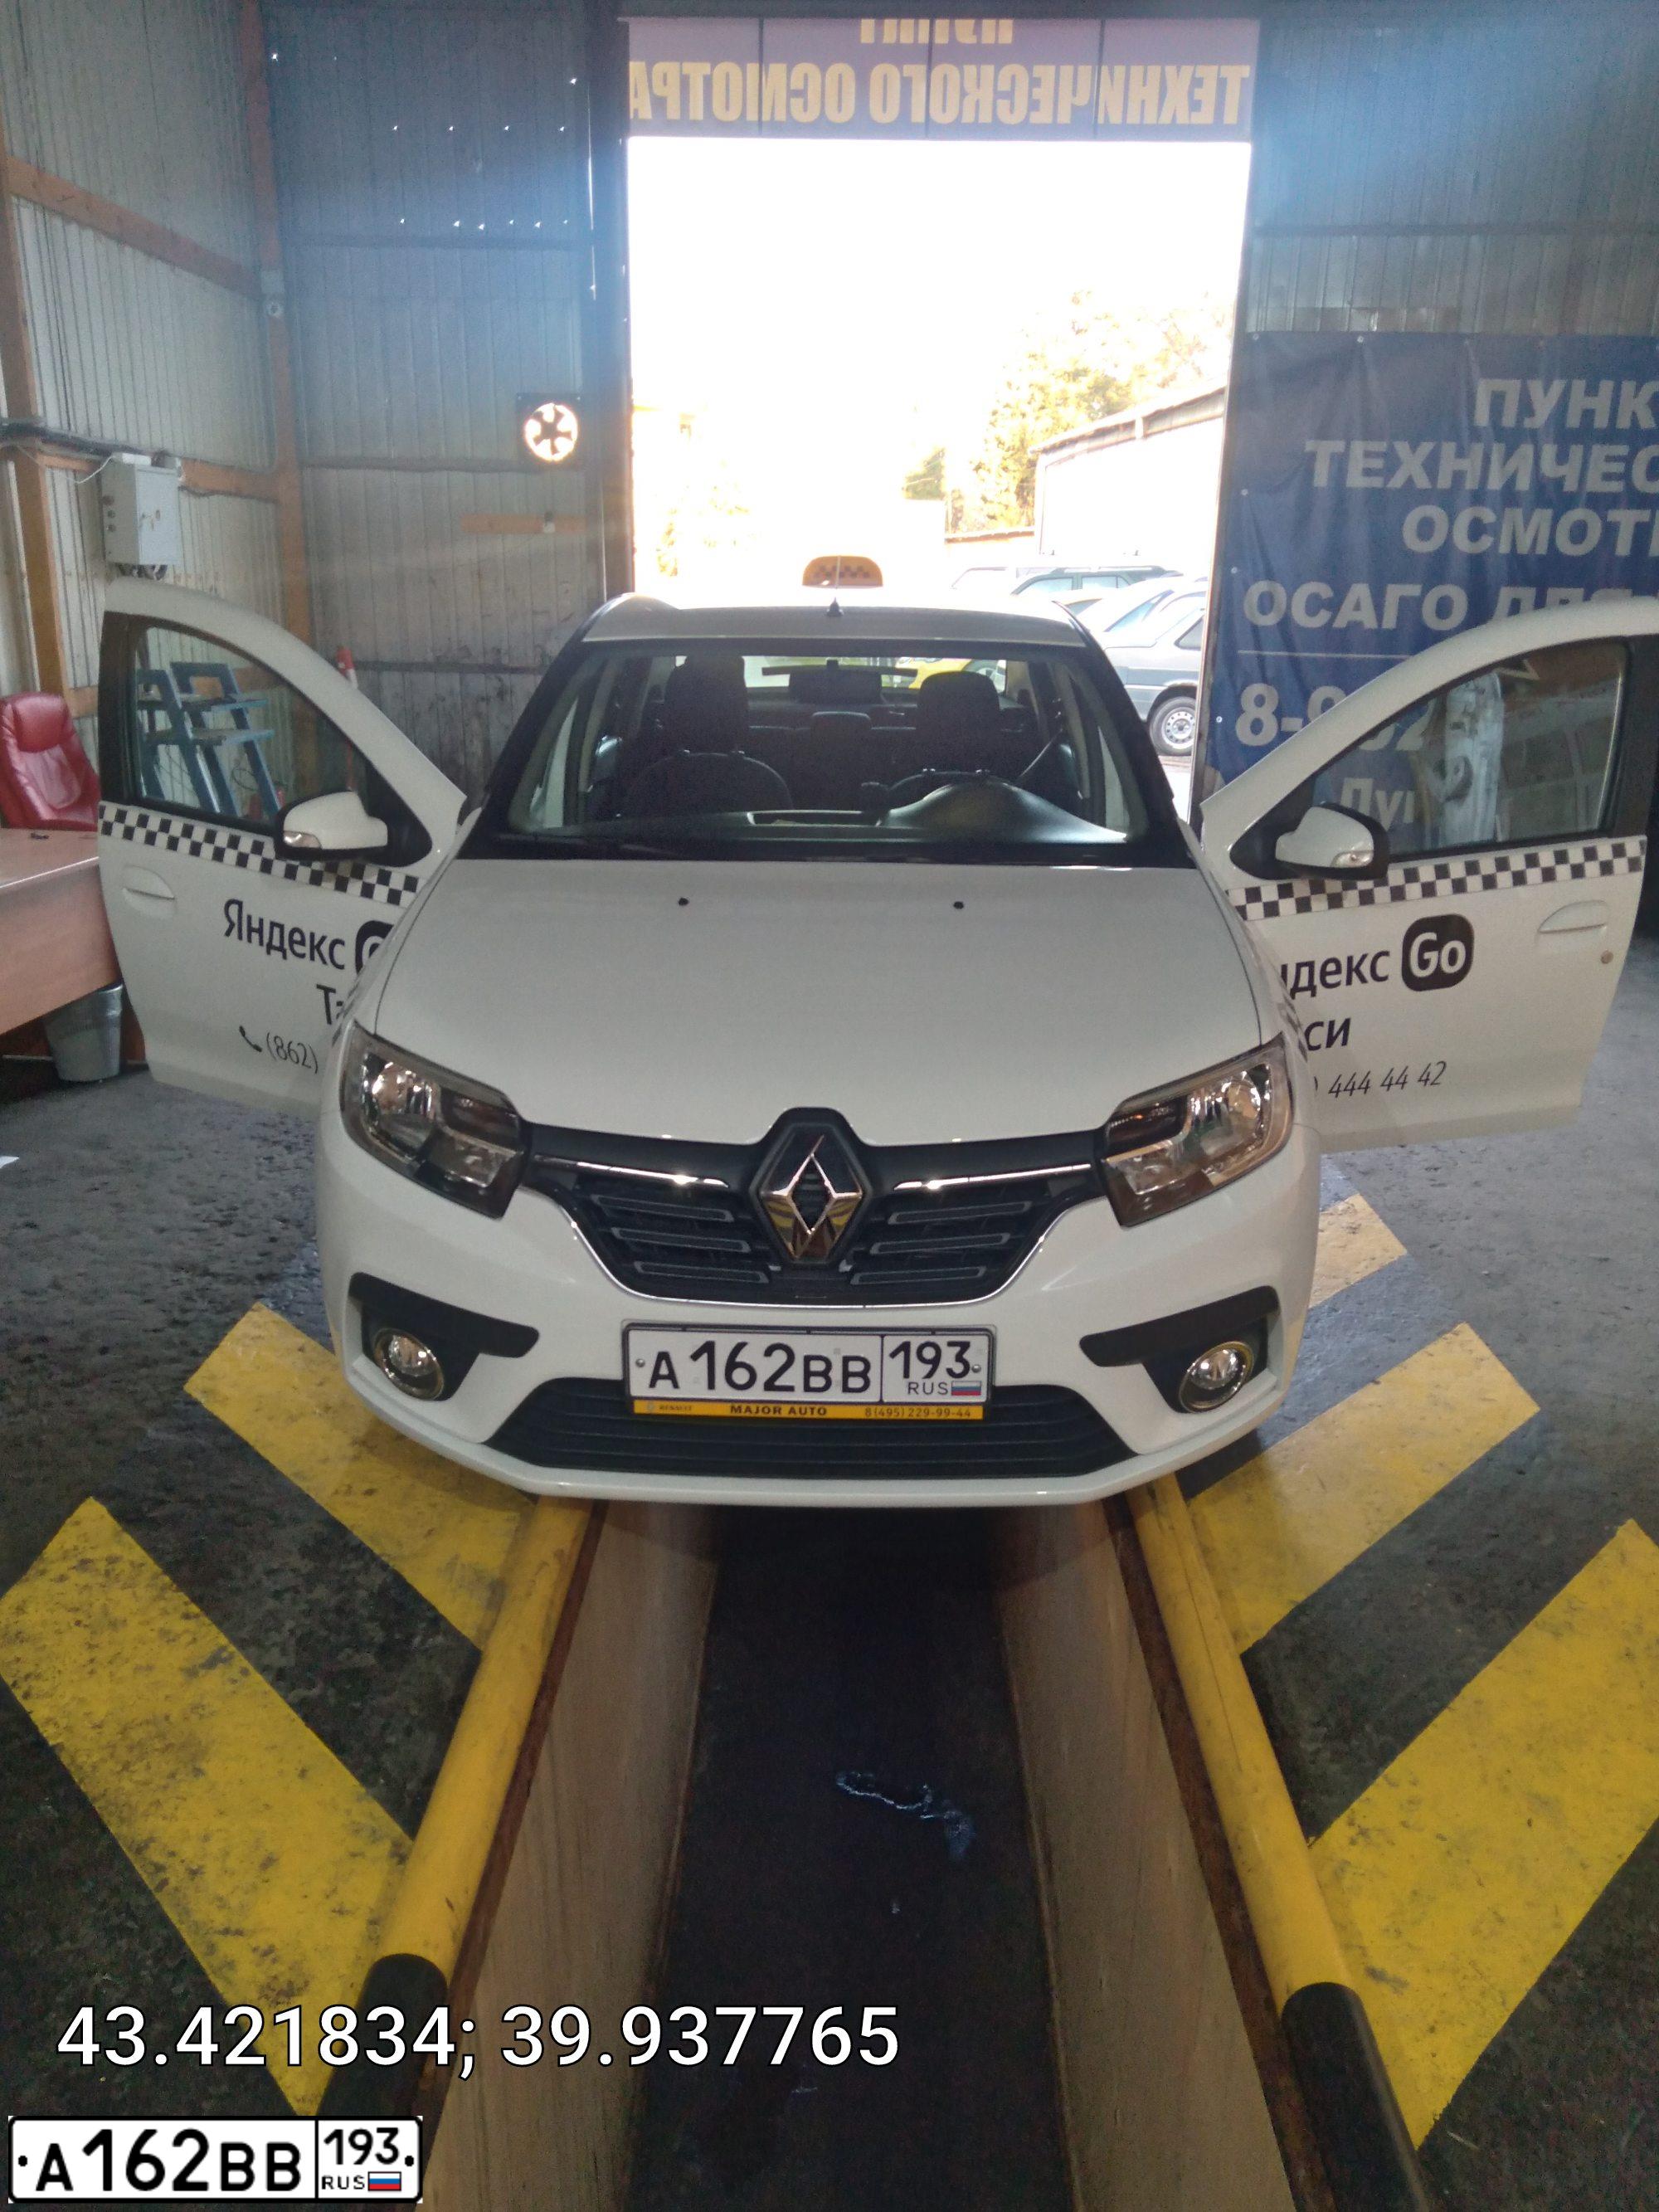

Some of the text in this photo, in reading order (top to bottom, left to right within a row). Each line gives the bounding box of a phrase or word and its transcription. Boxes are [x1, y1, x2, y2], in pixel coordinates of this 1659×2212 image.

[1403, 504, 1659, 557] ОСМОТ
[1243, 579, 1468, 631] ОСАГО
[223, 899, 345, 970] Яндекс
[1409, 931, 1467, 977] Go
[266, 1032, 319, 1074] (862)
[1328, 1060, 1447, 1099] 444 44 42
[888, 1341, 971, 1380] 193
[907, 1381, 949, 1396] RUS
[730, 1404, 827, 1416] MAJOR AUTO
